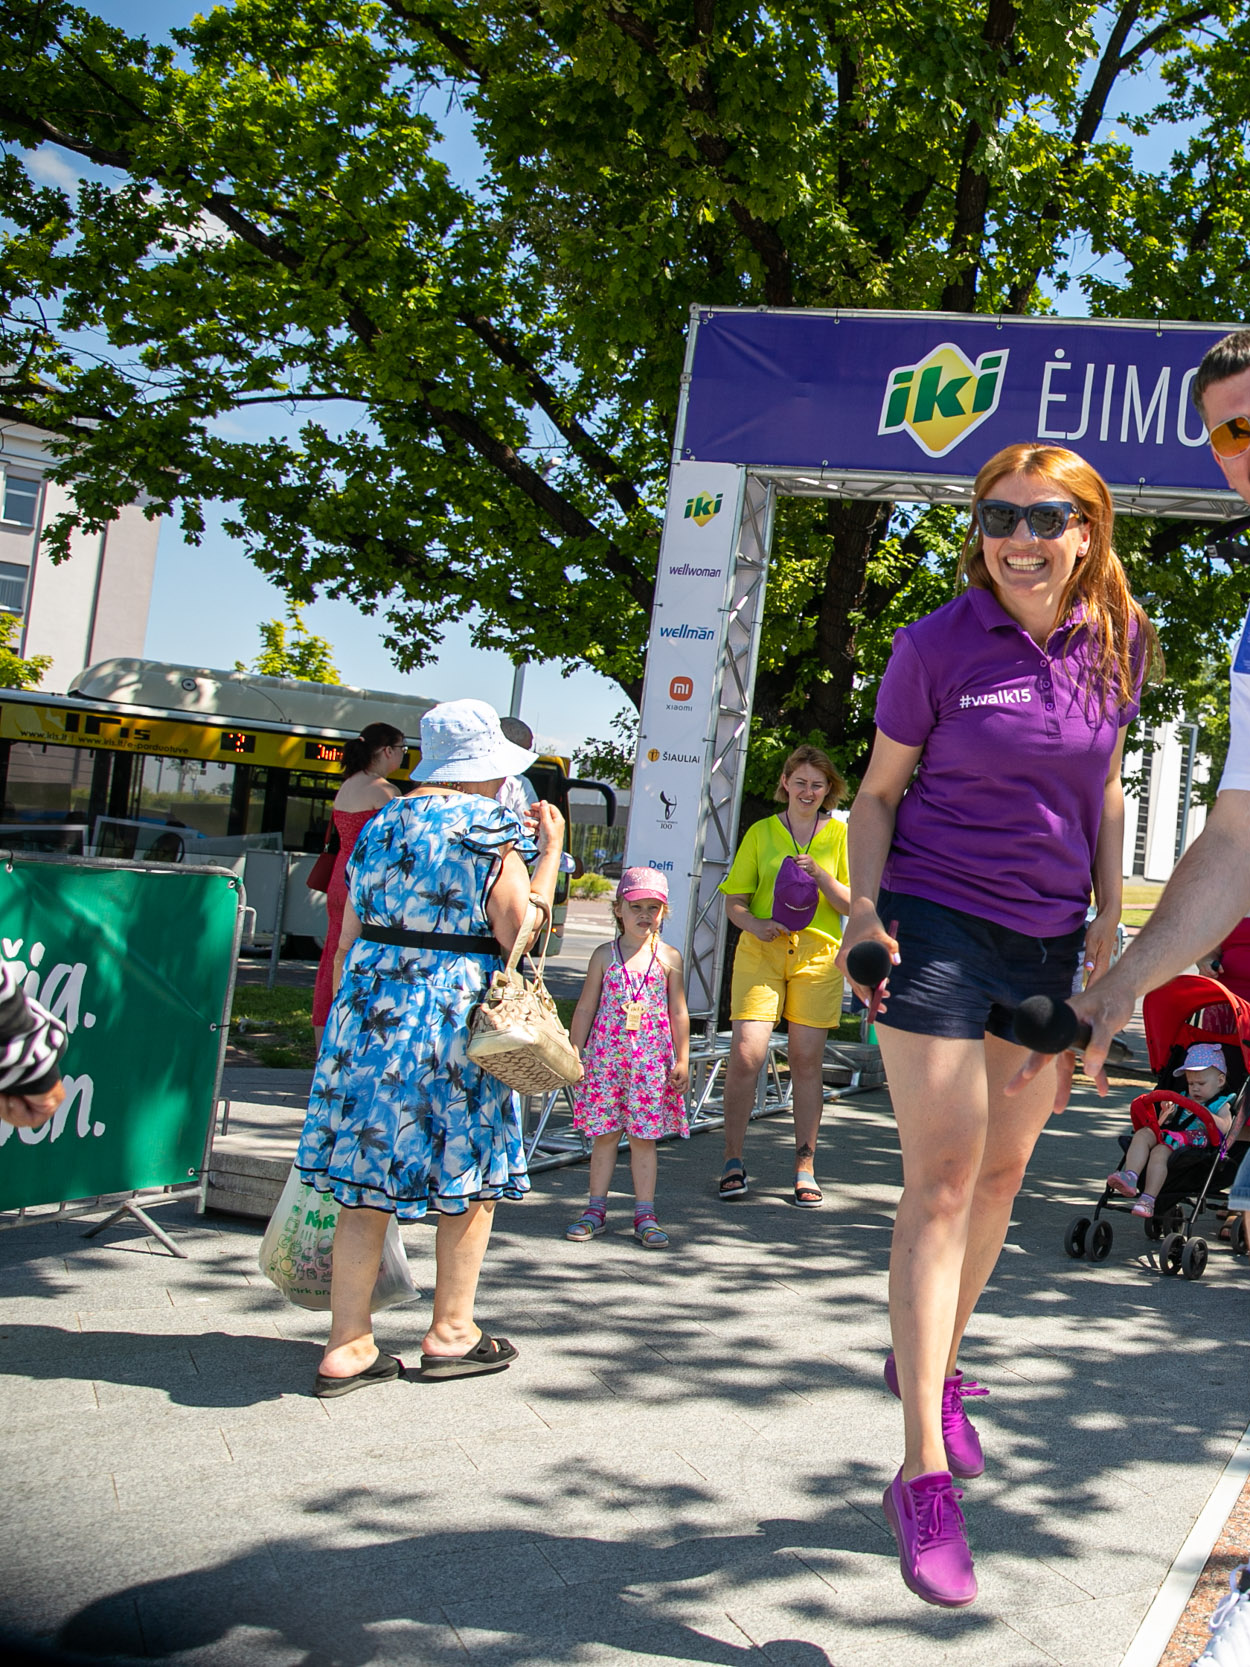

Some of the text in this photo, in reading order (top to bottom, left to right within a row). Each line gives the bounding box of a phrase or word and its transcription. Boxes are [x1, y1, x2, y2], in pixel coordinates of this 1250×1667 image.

[884, 355, 1003, 429] iki
[684, 493, 724, 519] iki
[669, 564, 722, 578] wellwoman
[959, 689, 1032, 708] #walk15
[662, 752, 700, 764] ŠIAULIAI
[648, 859, 674, 871] Delfi
